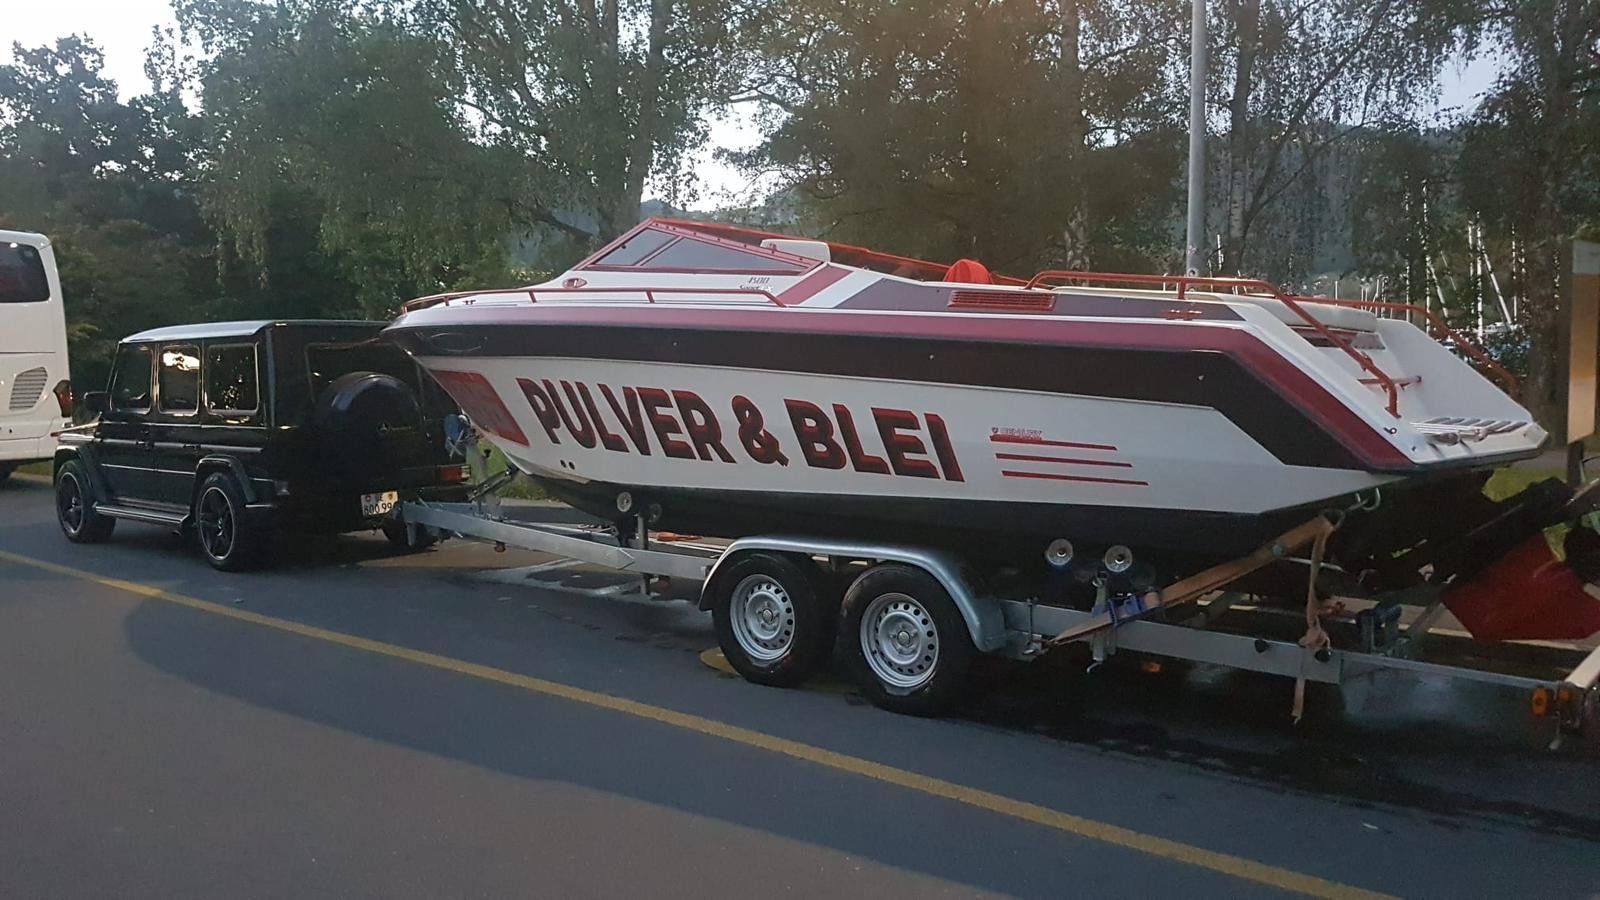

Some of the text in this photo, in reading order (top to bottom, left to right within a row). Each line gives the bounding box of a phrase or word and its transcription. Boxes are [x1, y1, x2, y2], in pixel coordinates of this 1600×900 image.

[515, 377, 965, 482] PULVER & BLEI
